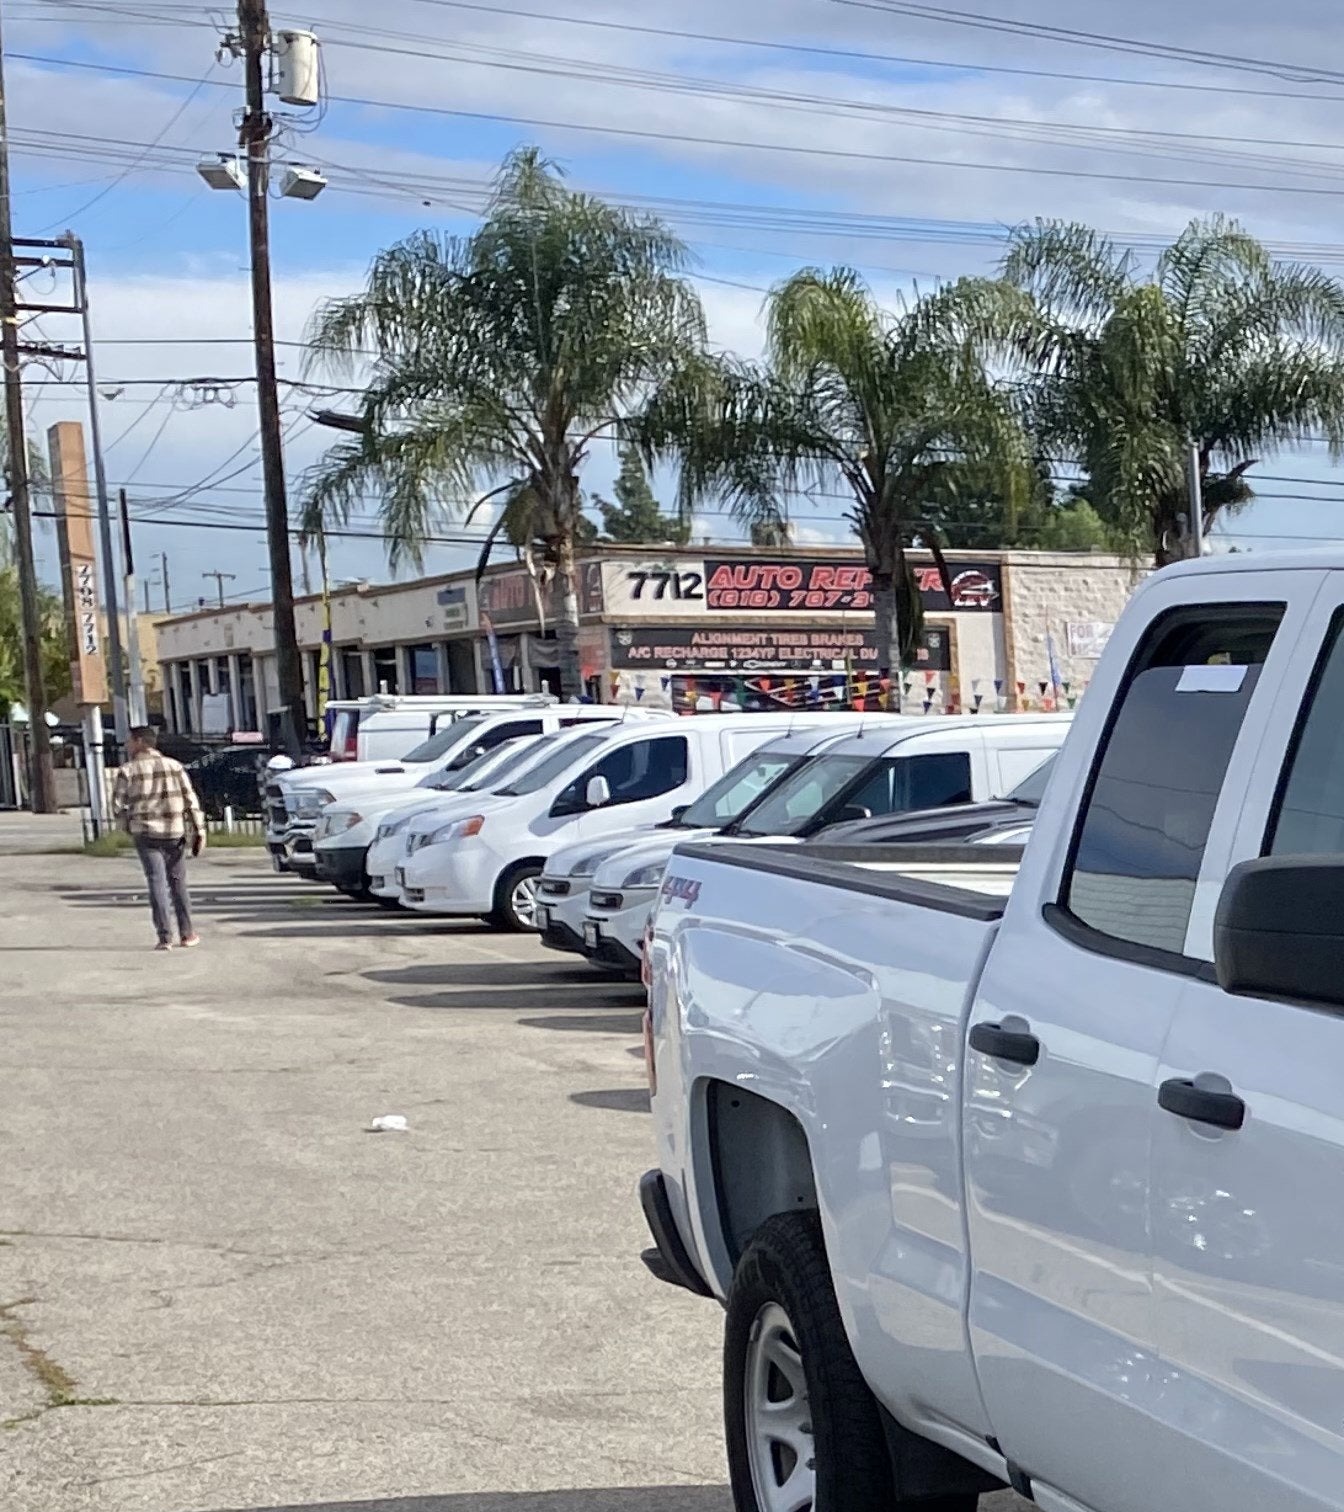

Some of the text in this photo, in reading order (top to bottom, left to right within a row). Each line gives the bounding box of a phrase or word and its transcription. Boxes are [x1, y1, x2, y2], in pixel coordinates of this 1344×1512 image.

[627, 572, 704, 600] 7712
[708, 565, 945, 592] AUTO REPR
[691, 632, 864, 647] ALIGNMENT TIRES BRAKES
[628, 646, 651, 659] A/C
[654, 647, 728, 659] RECHARGE
[778, 647, 858, 660] ELECTRICAL
